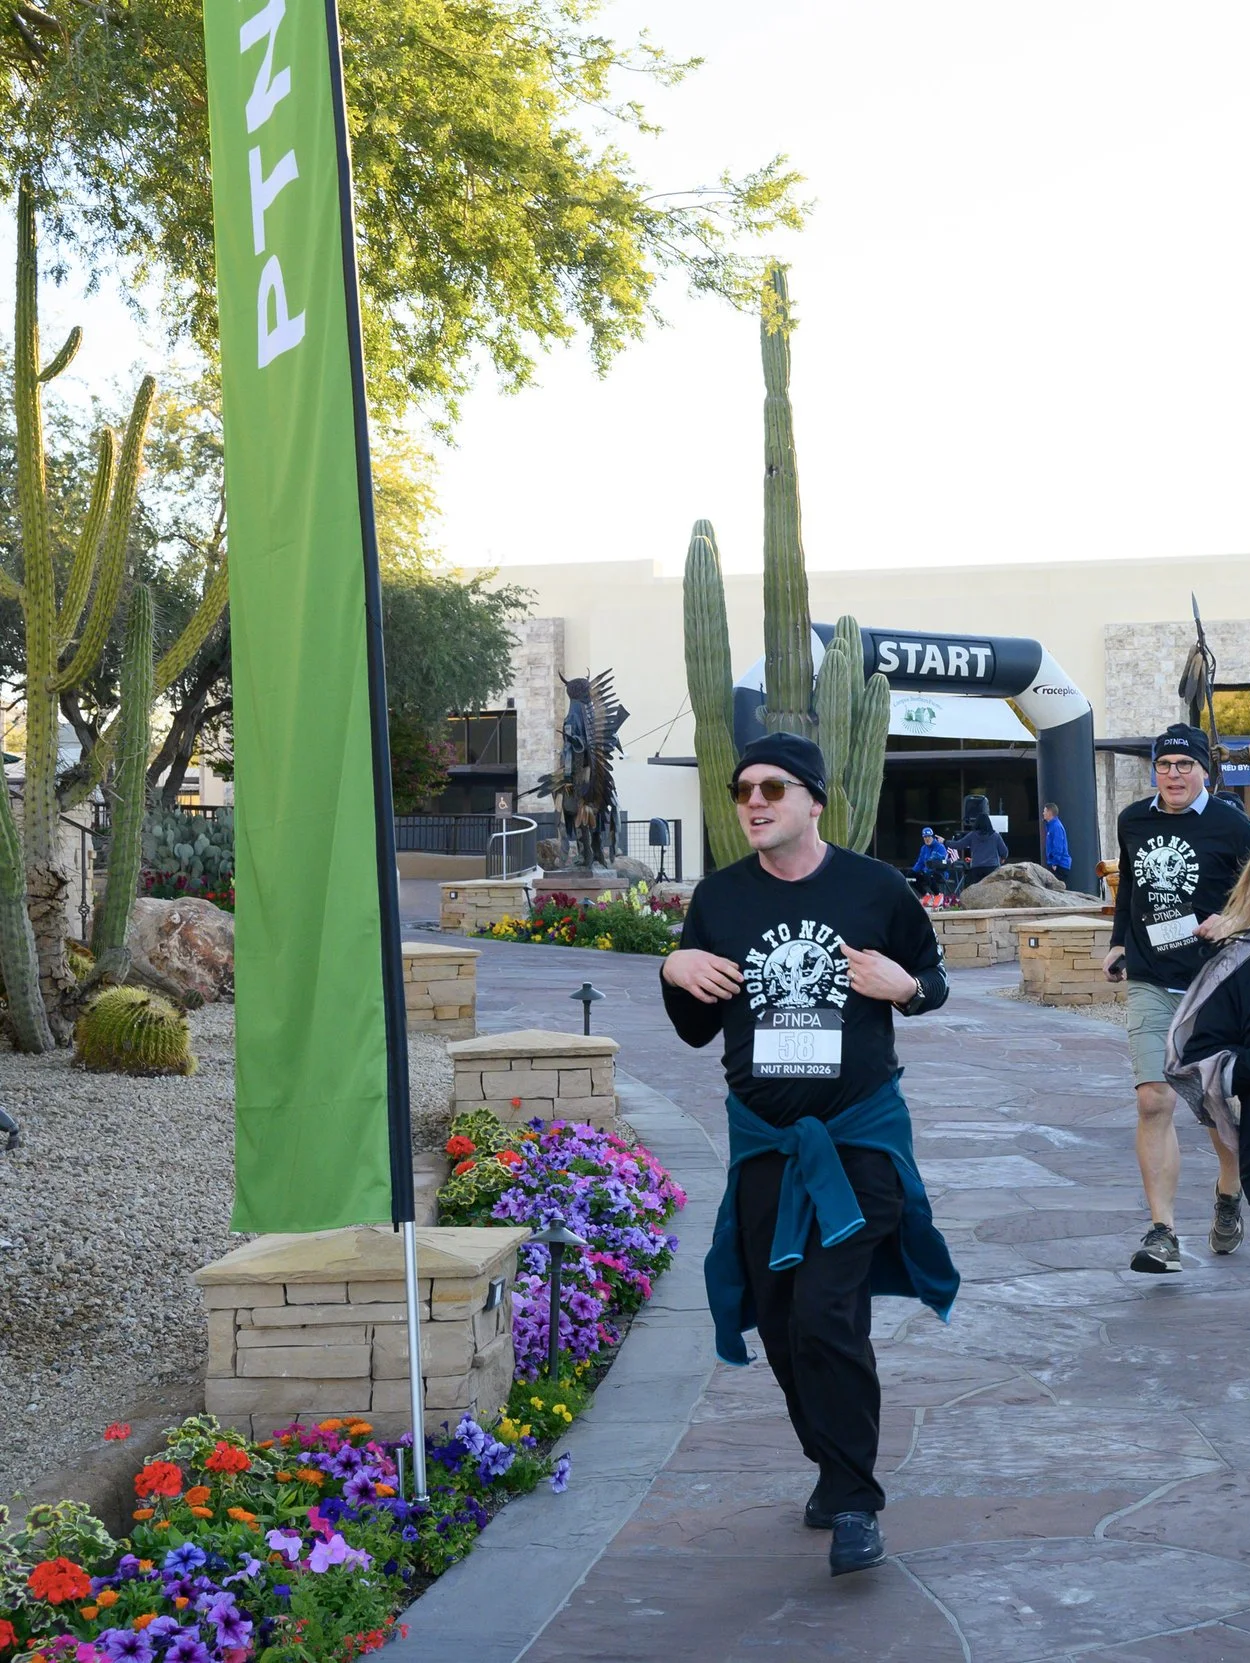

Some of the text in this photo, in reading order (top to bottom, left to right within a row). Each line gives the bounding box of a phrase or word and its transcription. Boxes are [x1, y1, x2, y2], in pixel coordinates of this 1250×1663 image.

[878, 640, 992, 678] START
[1221, 764, 1236, 772] RED
[1134, 835, 1199, 895] BORN TO NUT RUN
[1148, 891, 1182, 904] PTNPA
[1153, 908, 1182, 922] PTNPA
[1160, 920, 1185, 942] 32
[1157, 935, 1199, 952] NUT RUN 2026
[743, 919, 851, 1009] BORN TO NUT RUN
[772, 1012, 822, 1027] PTNPA
[778, 1031, 815, 1062] 58
[760, 1064, 832, 1074] NUT RUN 2026
